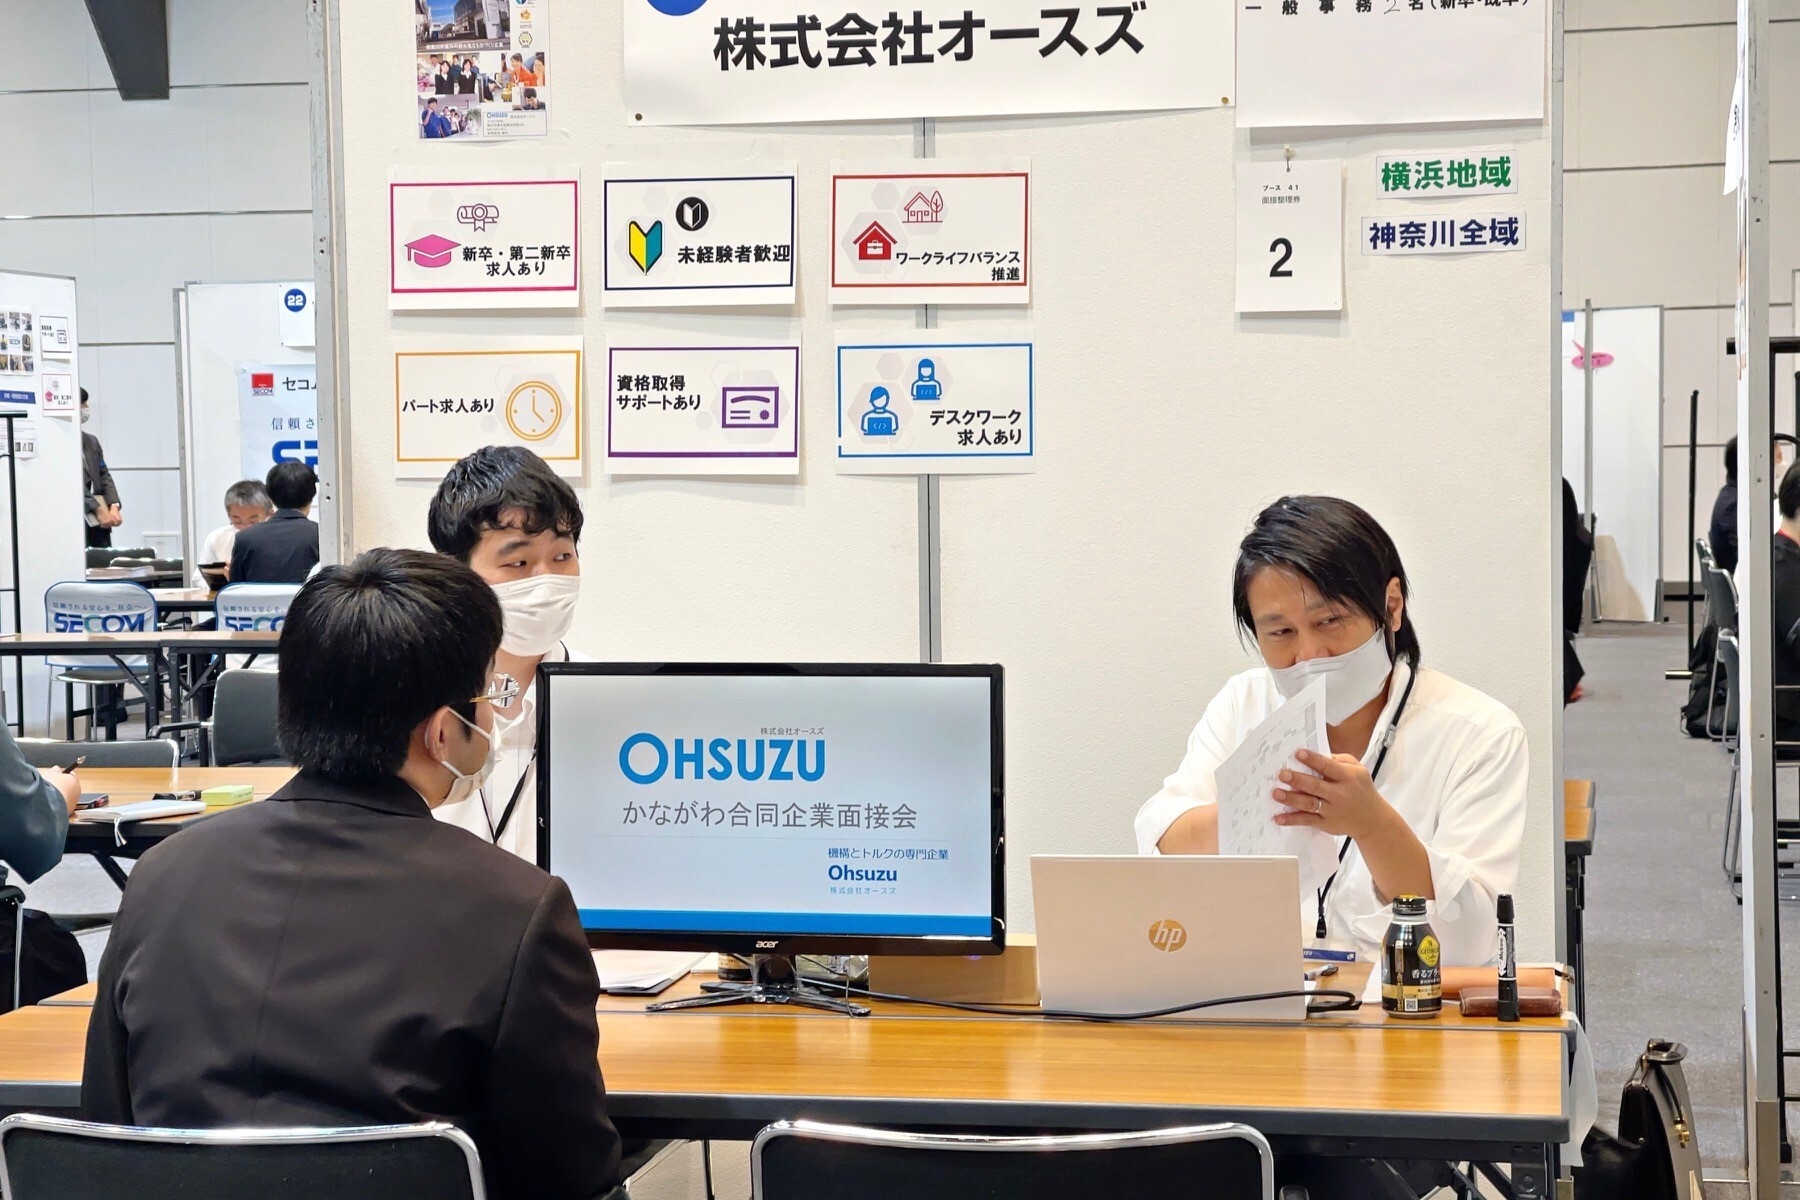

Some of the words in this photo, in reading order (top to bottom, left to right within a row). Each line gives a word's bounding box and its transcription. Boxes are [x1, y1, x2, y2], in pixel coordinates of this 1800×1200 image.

[713, 1, 1146, 71] 株式会社オースズ
[1381, 156, 1511, 191] 横浜地域
[1261, 195, 1300, 204] 面接整理券
[1369, 217, 1519, 250] 神奈川全域
[462, 244, 571, 261] 新卒・第二新卒
[678, 244, 791, 265] 未経験者歓迎
[896, 251, 1021, 265] ワークライフバランス
[1269, 237, 1293, 278] 2
[486, 261, 546, 276] 求人あり
[991, 267, 1020, 281] 推進
[287, 294, 304, 306] 22
[617, 375, 685, 391] 資格取得
[402, 398, 494, 413] パート求人あり
[617, 394, 700, 410] サポートあり
[271, 417, 315, 431] 信頼さ
[930, 410, 1021, 426] デスクワーク
[957, 429, 1022, 446] 求人あり
[53, 612, 145, 633] SECOM
[760, 727, 824, 736] 株式会社オースズ
[619, 732, 826, 785] OHSUZU
[622, 800, 918, 829] かながわ合同企業面接会
[828, 847, 949, 860] 機構とトルクの専門企業
[828, 864, 898, 881] Ohsuzu
[830, 886, 896, 895] 株式会社オースズ
[1153, 919, 1183, 952] hp
[756, 940, 778, 949] acer
